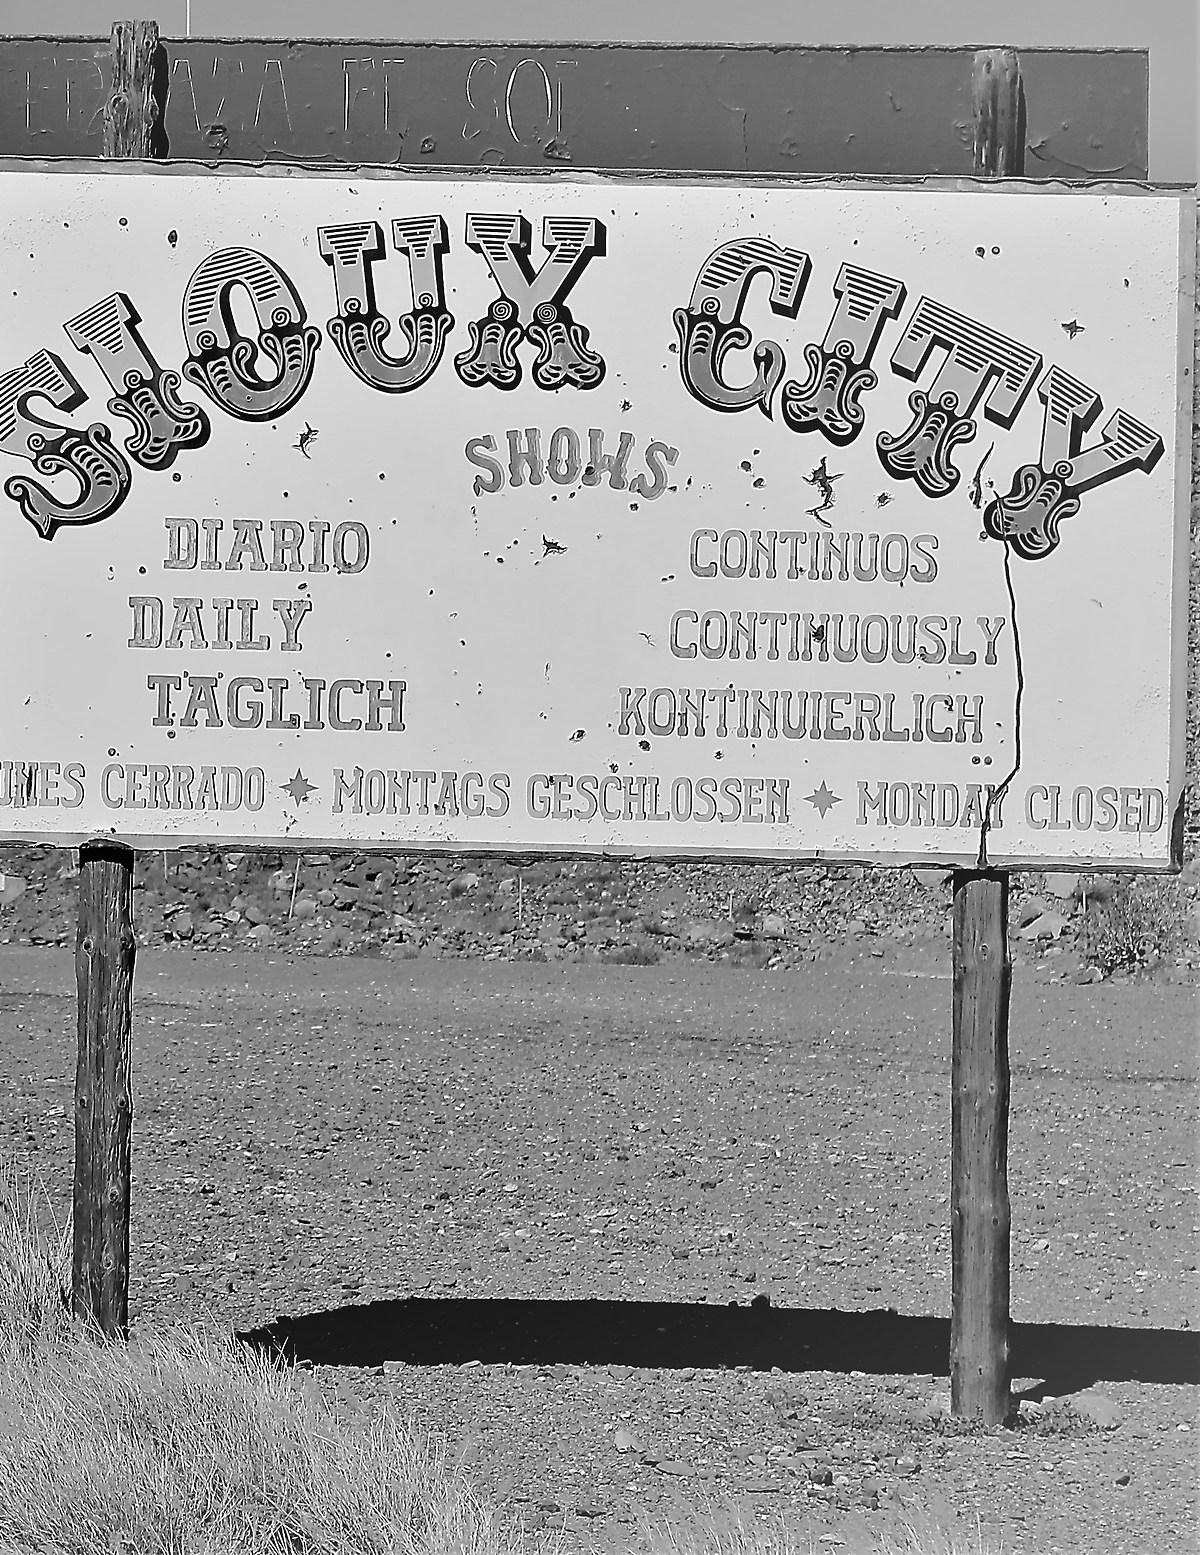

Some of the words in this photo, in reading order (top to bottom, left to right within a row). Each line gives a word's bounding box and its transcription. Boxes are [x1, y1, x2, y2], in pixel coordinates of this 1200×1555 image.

[673, 237, 1166, 560] CITY
[465, 426, 679, 500] SHOWS
[163, 517, 370, 574] DIARIO
[689, 529, 939, 583] CONTINUOS
[127, 596, 312, 651] DAILY
[670, 609, 1006, 665] CONTINUOUSLY
[617, 687, 984, 743] KONTINUIERLICH
[101, 763, 266, 811] CERRADO
[331, 767, 511, 818] MONTAGS
[525, 774, 791, 824] GESCHLOSSEN
[855, 780, 1009, 829] MONDAY
[1024, 784, 1165, 834] CLOSED
